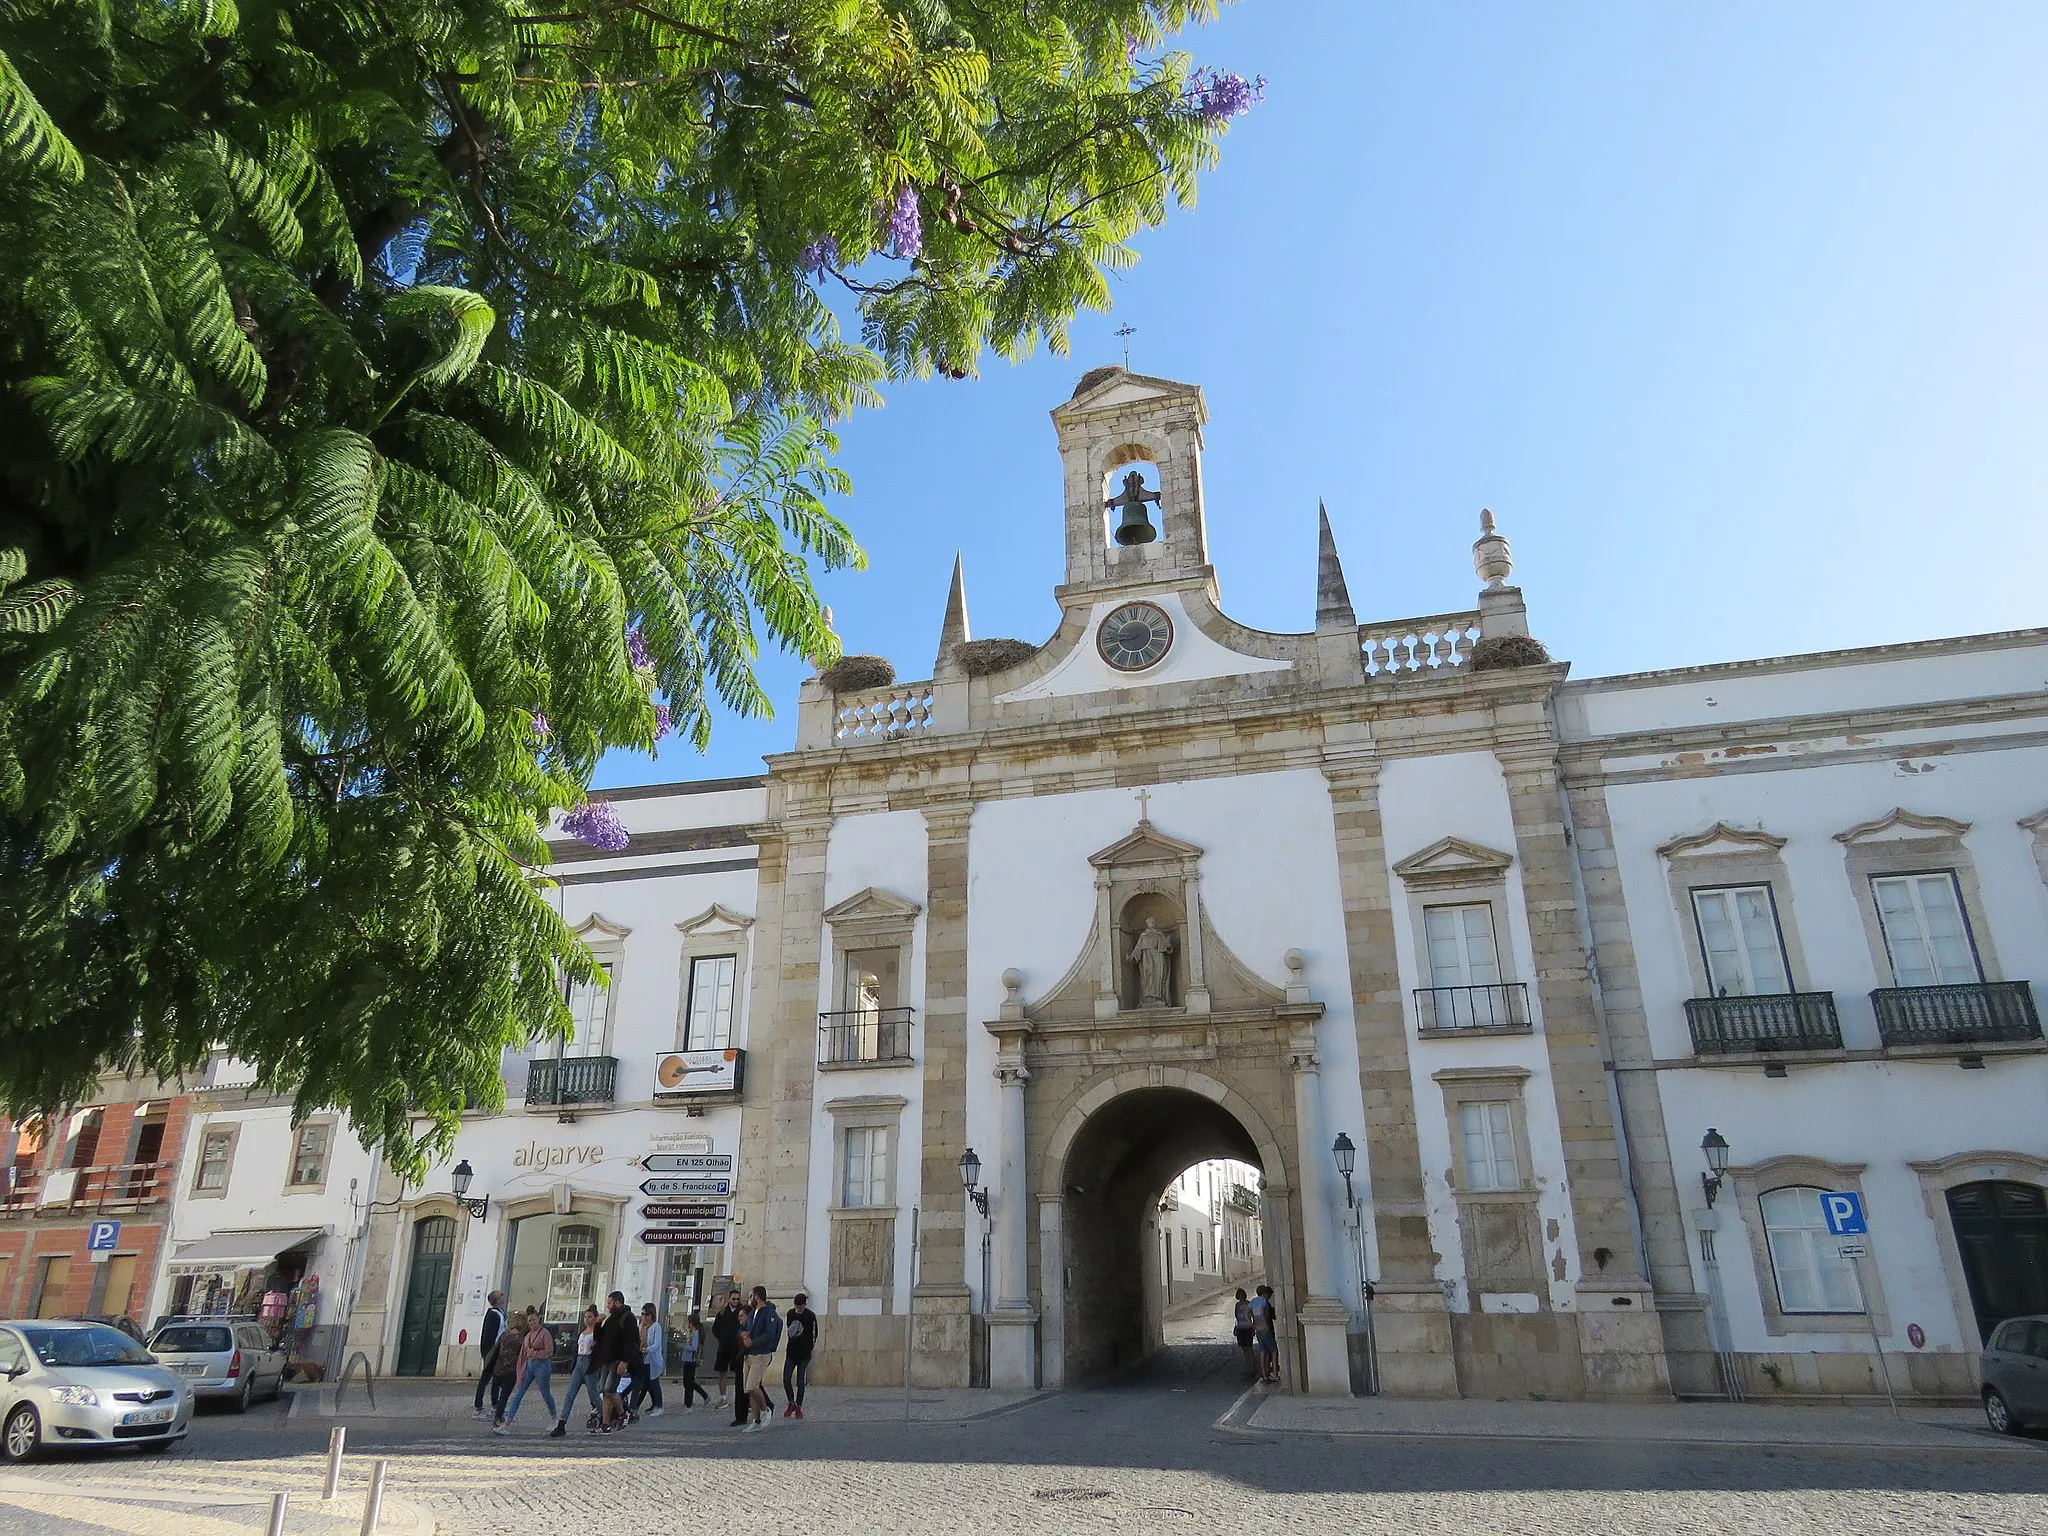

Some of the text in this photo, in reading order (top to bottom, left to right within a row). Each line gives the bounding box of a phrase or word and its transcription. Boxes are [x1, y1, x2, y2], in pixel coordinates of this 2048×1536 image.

[513, 1141, 604, 1171] algarve
[706, 1158, 730, 1166] Olhão
[660, 1182, 670, 1190] de
[682, 1182, 717, 1190] Francisco
[646, 1205, 716, 1216] biblioteca municipal
[645, 1231, 714, 1241] museu municipal
